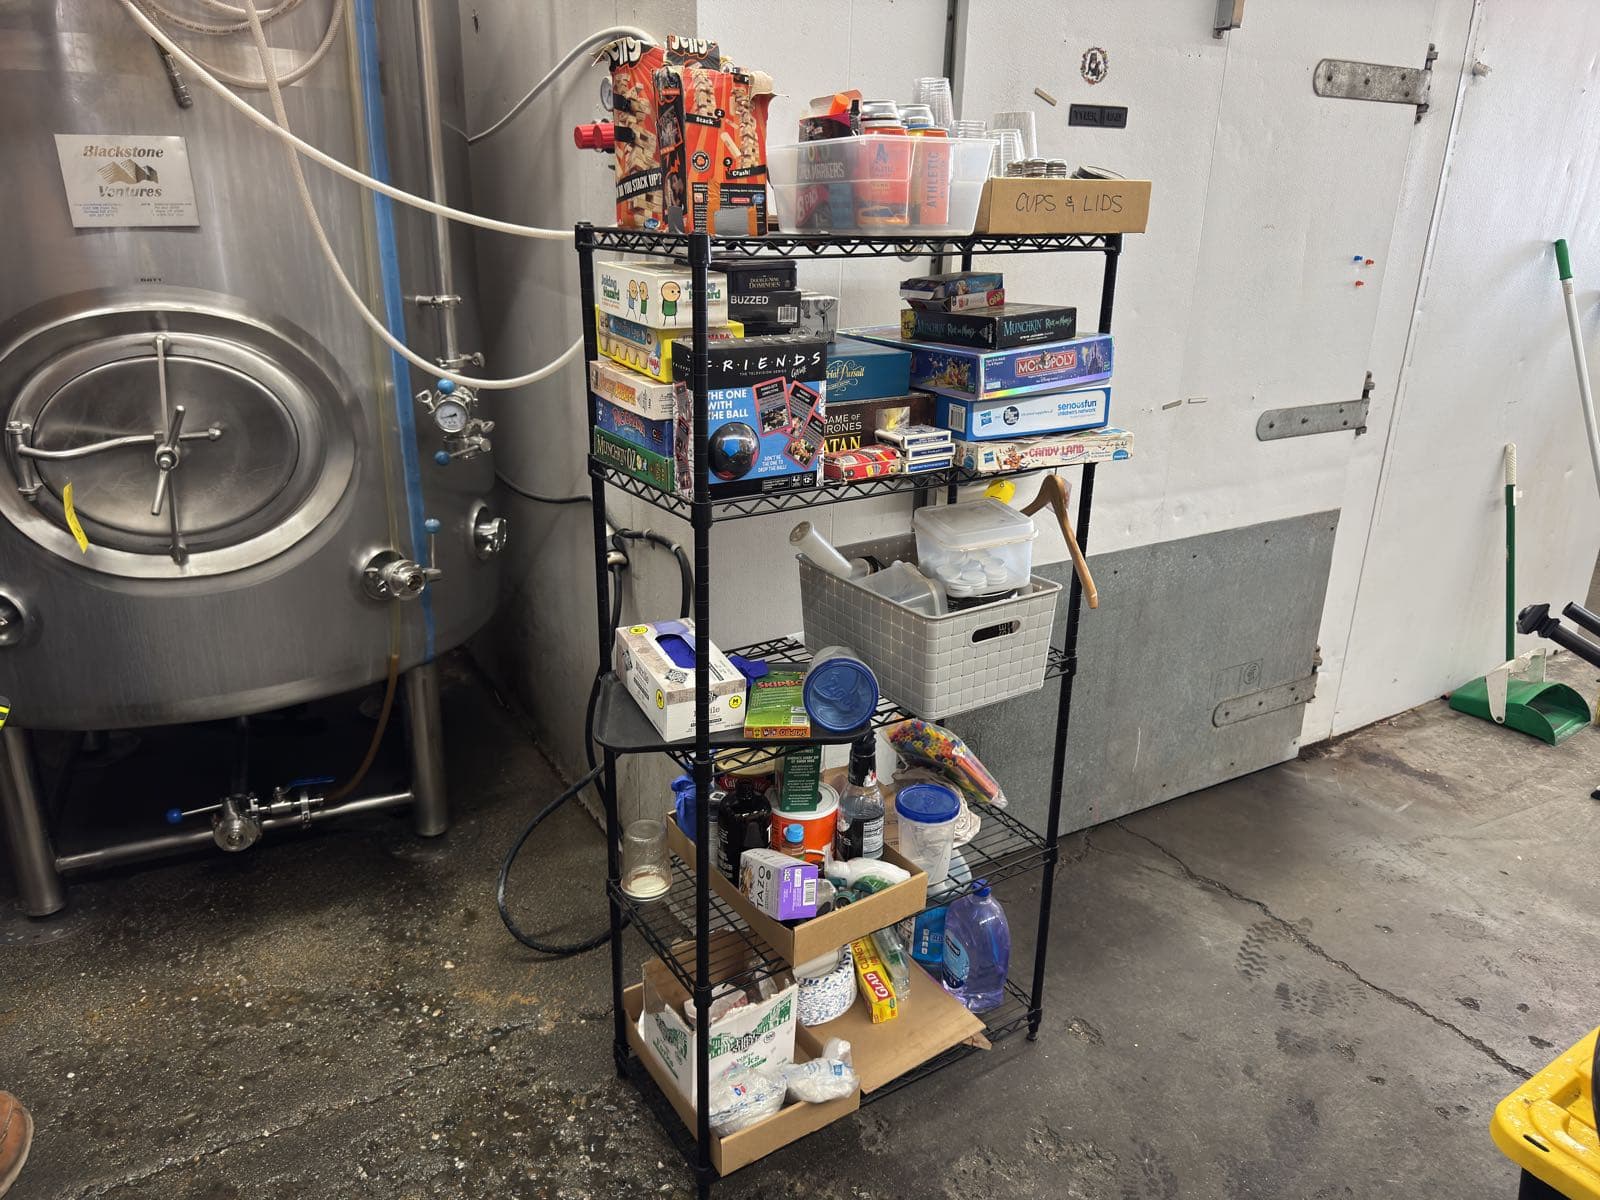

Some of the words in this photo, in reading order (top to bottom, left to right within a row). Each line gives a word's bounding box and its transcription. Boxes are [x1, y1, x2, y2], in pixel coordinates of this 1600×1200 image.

[695, 116, 714, 125] Stack
[83, 144, 164, 158] Blackstone
[732, 169, 750, 178] Crash!
[927, 151, 939, 208] ATHLETIC
[632, 176, 649, 192] STACK
[649, 172, 663, 188] UP?
[98, 185, 162, 198] Ventures
[1015, 192, 1057, 213] CUPS
[1083, 194, 1123, 213] LIDS
[748, 281, 781, 289] DOMINOES
[730, 295, 769, 305] BUZZED
[1003, 319, 1043, 336] MUNCHKIN
[708, 391, 724, 401] THE
[725, 389, 748, 399] ONE
[708, 401, 733, 411] WITH
[1057, 400, 1097, 411] seriousfun
[708, 411, 726, 420] THE
[726, 409, 749, 419] BALL
[824, 414, 849, 424] GAME
[823, 436, 861, 454] ATAN
[1028, 447, 1058, 458] CANDY
[1060, 444, 1085, 456] LAND
[597, 434, 627, 466] MUNCHKIN
[626, 447, 637, 471] OZ
[756, 865, 766, 908] TAZO
[865, 972, 889, 999] GLAD
